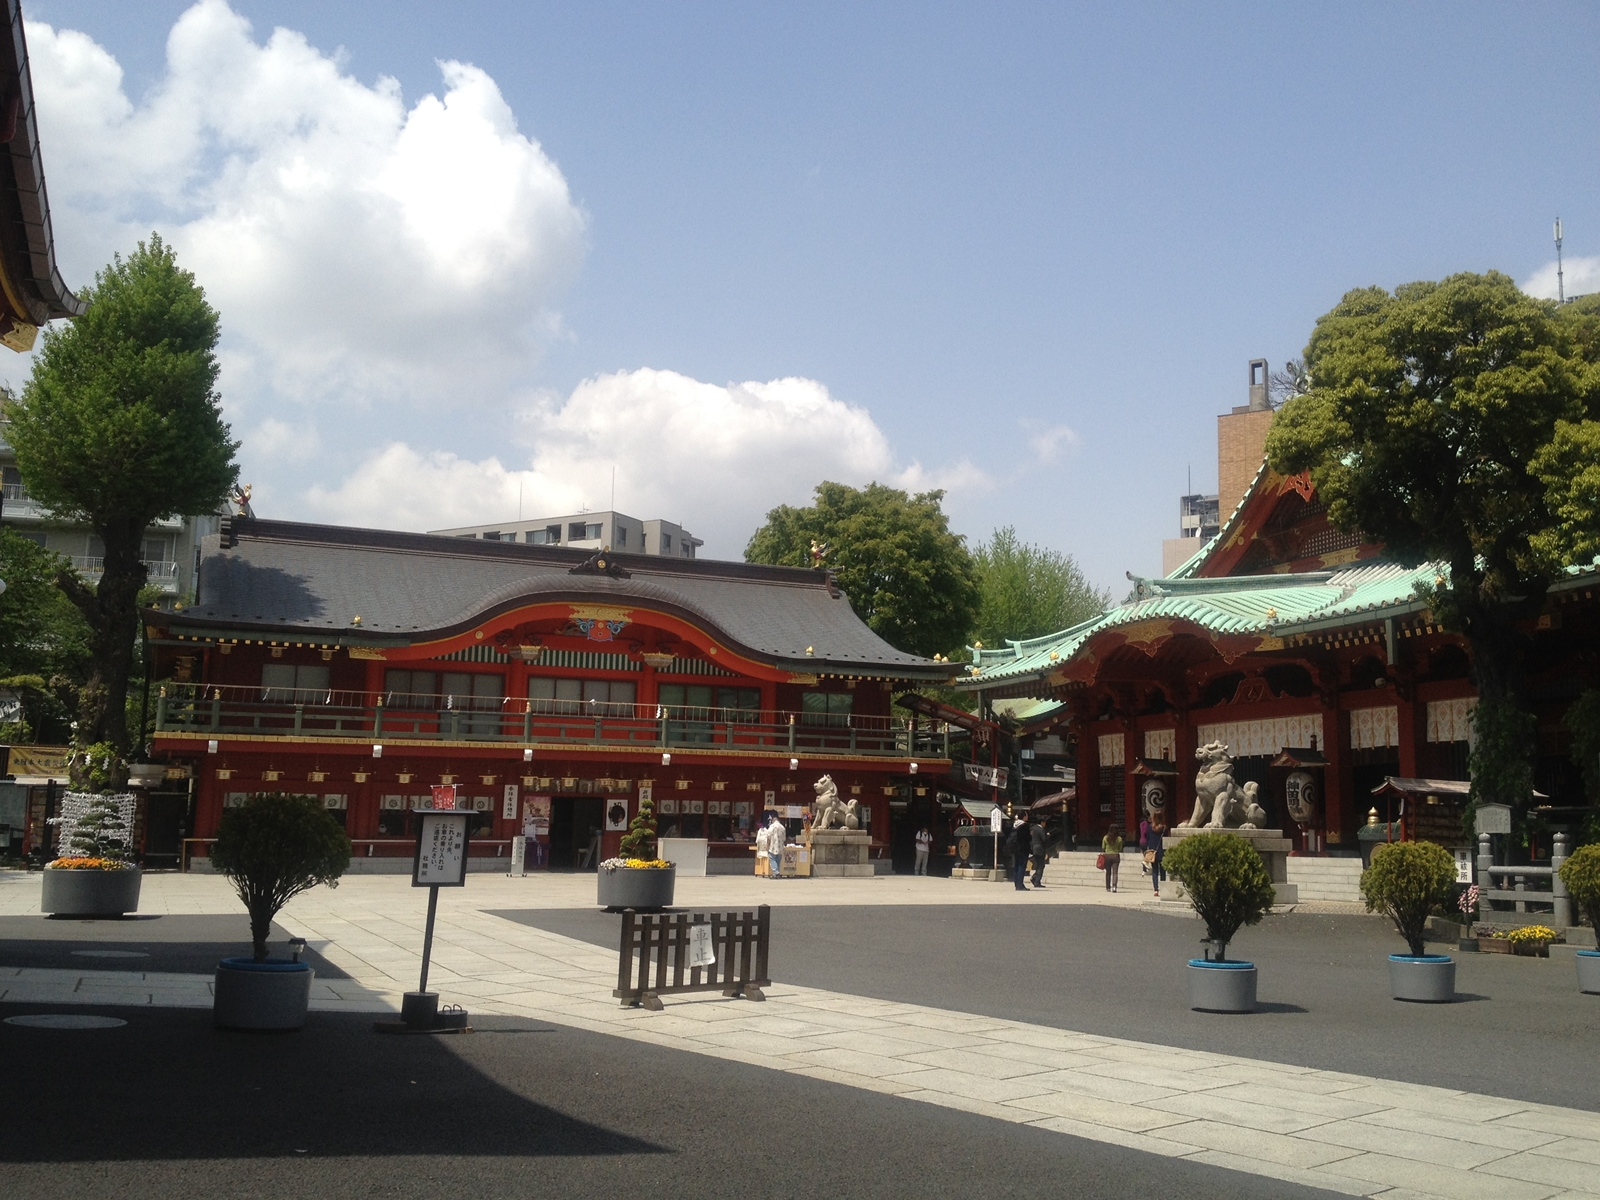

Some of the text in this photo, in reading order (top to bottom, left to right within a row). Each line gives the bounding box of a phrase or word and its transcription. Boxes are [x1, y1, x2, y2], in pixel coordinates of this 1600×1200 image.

[437, 823, 448, 871] お車の乗り入れは
[454, 831, 462, 861] お願い
